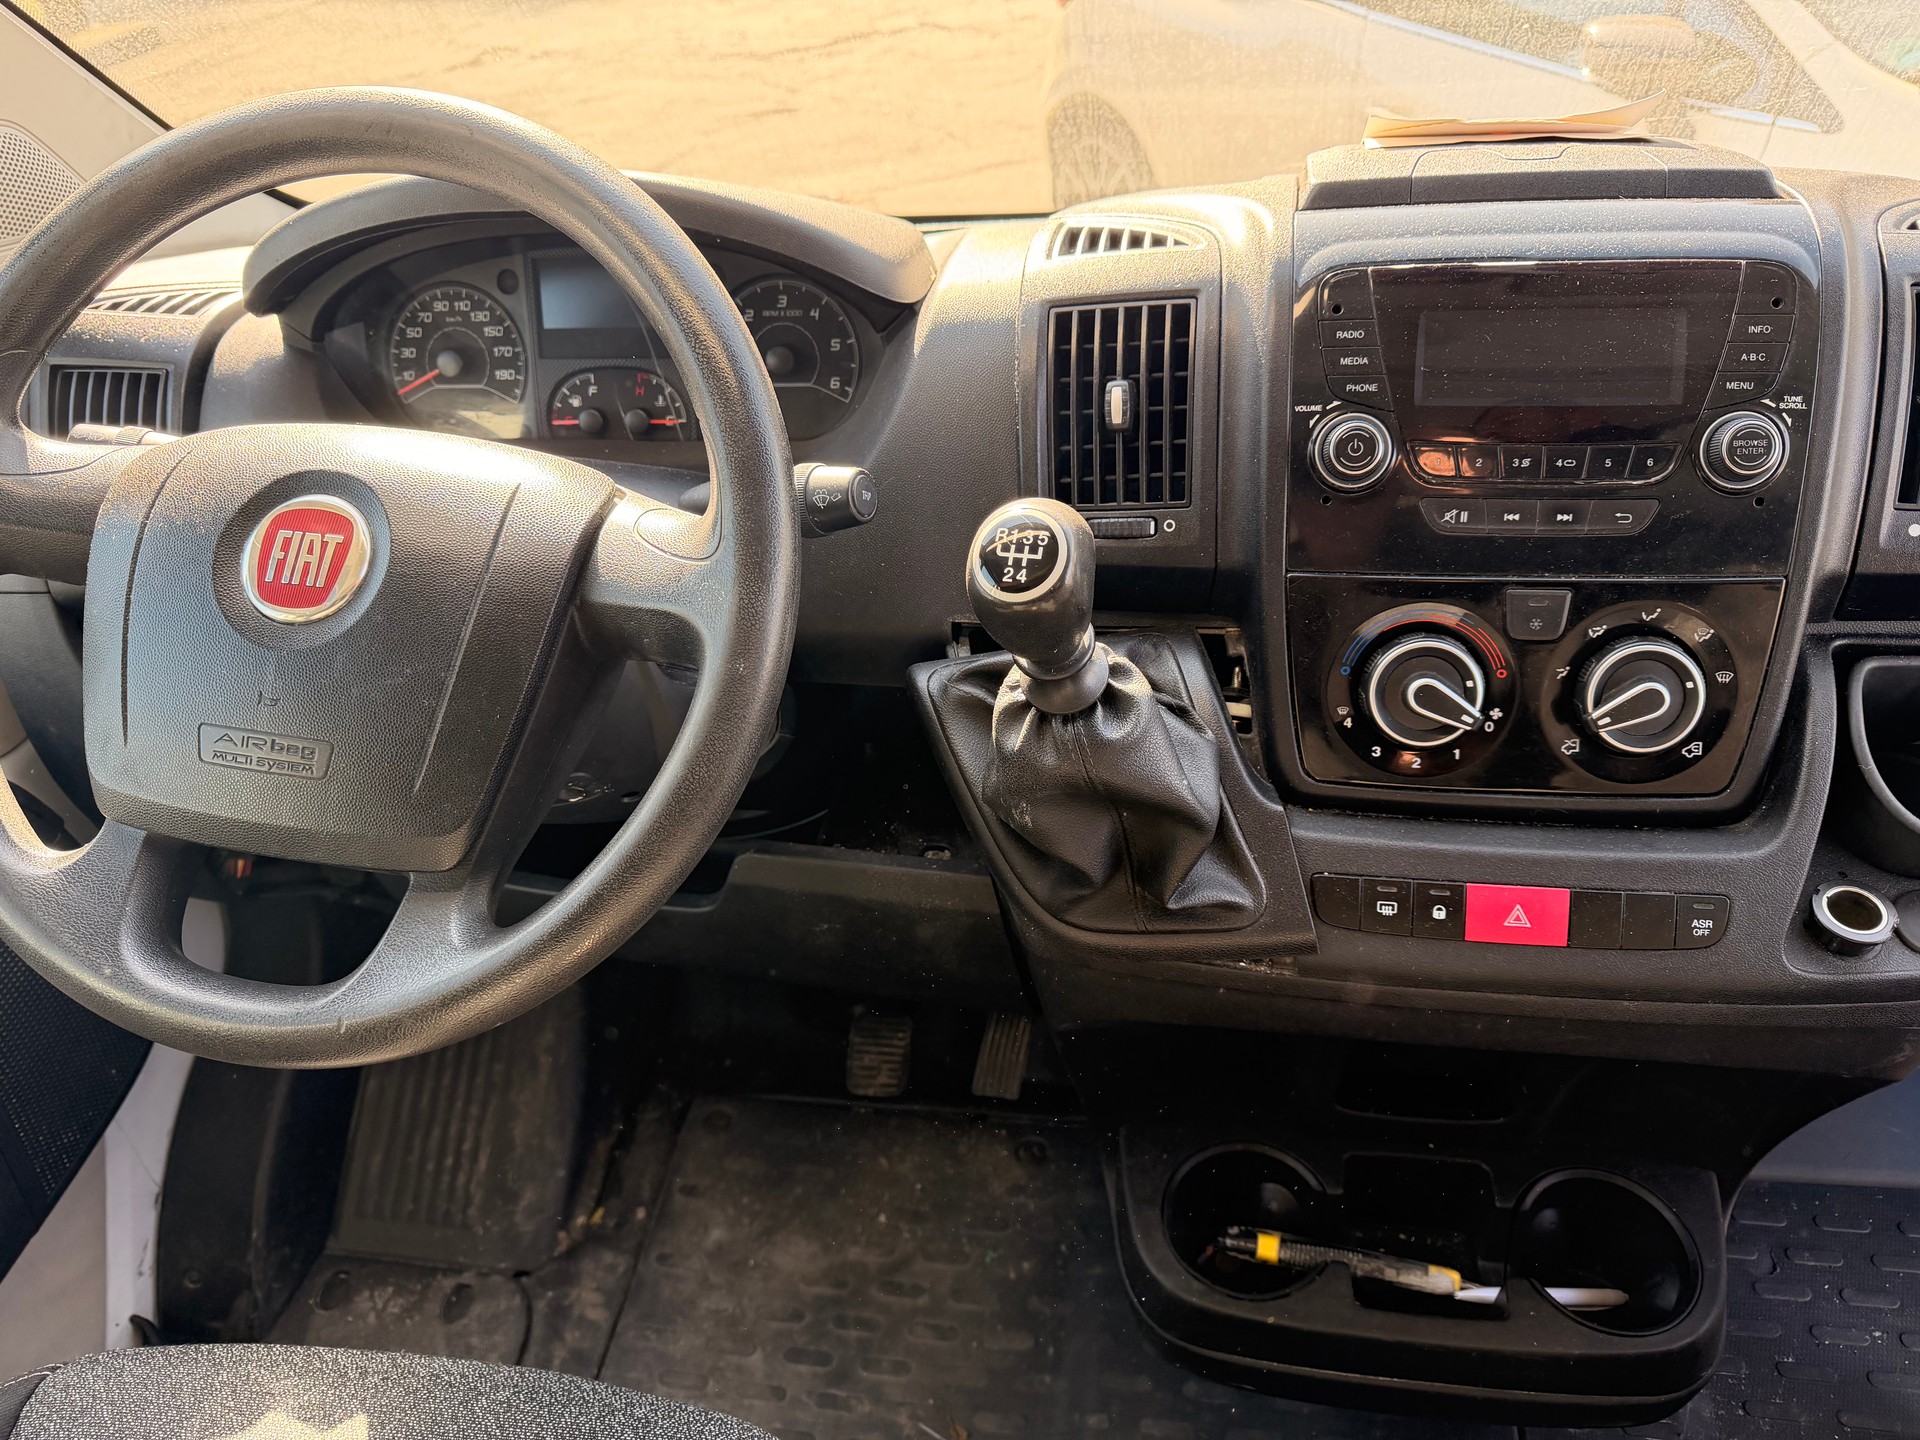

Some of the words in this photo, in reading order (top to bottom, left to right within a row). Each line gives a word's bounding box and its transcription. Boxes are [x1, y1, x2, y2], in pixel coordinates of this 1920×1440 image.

[433, 301, 449, 311] 90
[454, 301, 471, 311] 110
[777, 295, 788, 308] 3
[418, 312, 432, 322] 70
[470, 311, 490, 322] 130
[744, 309, 754, 321] 2
[810, 308, 820, 320] 4
[406, 327, 422, 338] 50
[483, 326, 504, 337] 150
[1336, 330, 1365, 339] RADIO
[1748, 325, 1771, 334] INFO
[830, 338, 841, 351] 5
[400, 347, 417, 358] 30
[493, 346, 513, 357] 170
[1340, 356, 1368, 365] MEDIA
[402, 370, 416, 381] 10
[494, 369, 515, 380] 190
[830, 377, 841, 389] 6
[1346, 383, 1379, 392] PHONE
[1726, 381, 1754, 390] MENU
[588, 385, 598, 397] F
[635, 386, 645, 397] H
[1294, 404, 1323, 412] VOLUME
[1778, 402, 1808, 410] SCROLL
[1733, 439, 1769, 447] BROWSE
[1737, 447, 1764, 455] ENTER
[1475, 458, 1483, 467] 2
[1512, 458, 1519, 467] 3
[1555, 458, 1563, 467] 4
[1604, 458, 1612, 467] 5
[1646, 458, 1654, 467] 6
[995, 527, 1009, 542] R
[1010, 529, 1019, 543] 1
[1022, 530, 1034, 544] 3
[1037, 531, 1049, 546] 5
[265, 529, 345, 588] FIAT
[1002, 567, 1014, 583] 2
[1016, 568, 1027, 583] 4
[1343, 717, 1353, 728] 4
[1484, 721, 1495, 732] 0
[1371, 746, 1381, 757] 3
[1452, 749, 1460, 760] 1
[1411, 757, 1422, 769] 2
[1691, 919, 1713, 928] ASR
